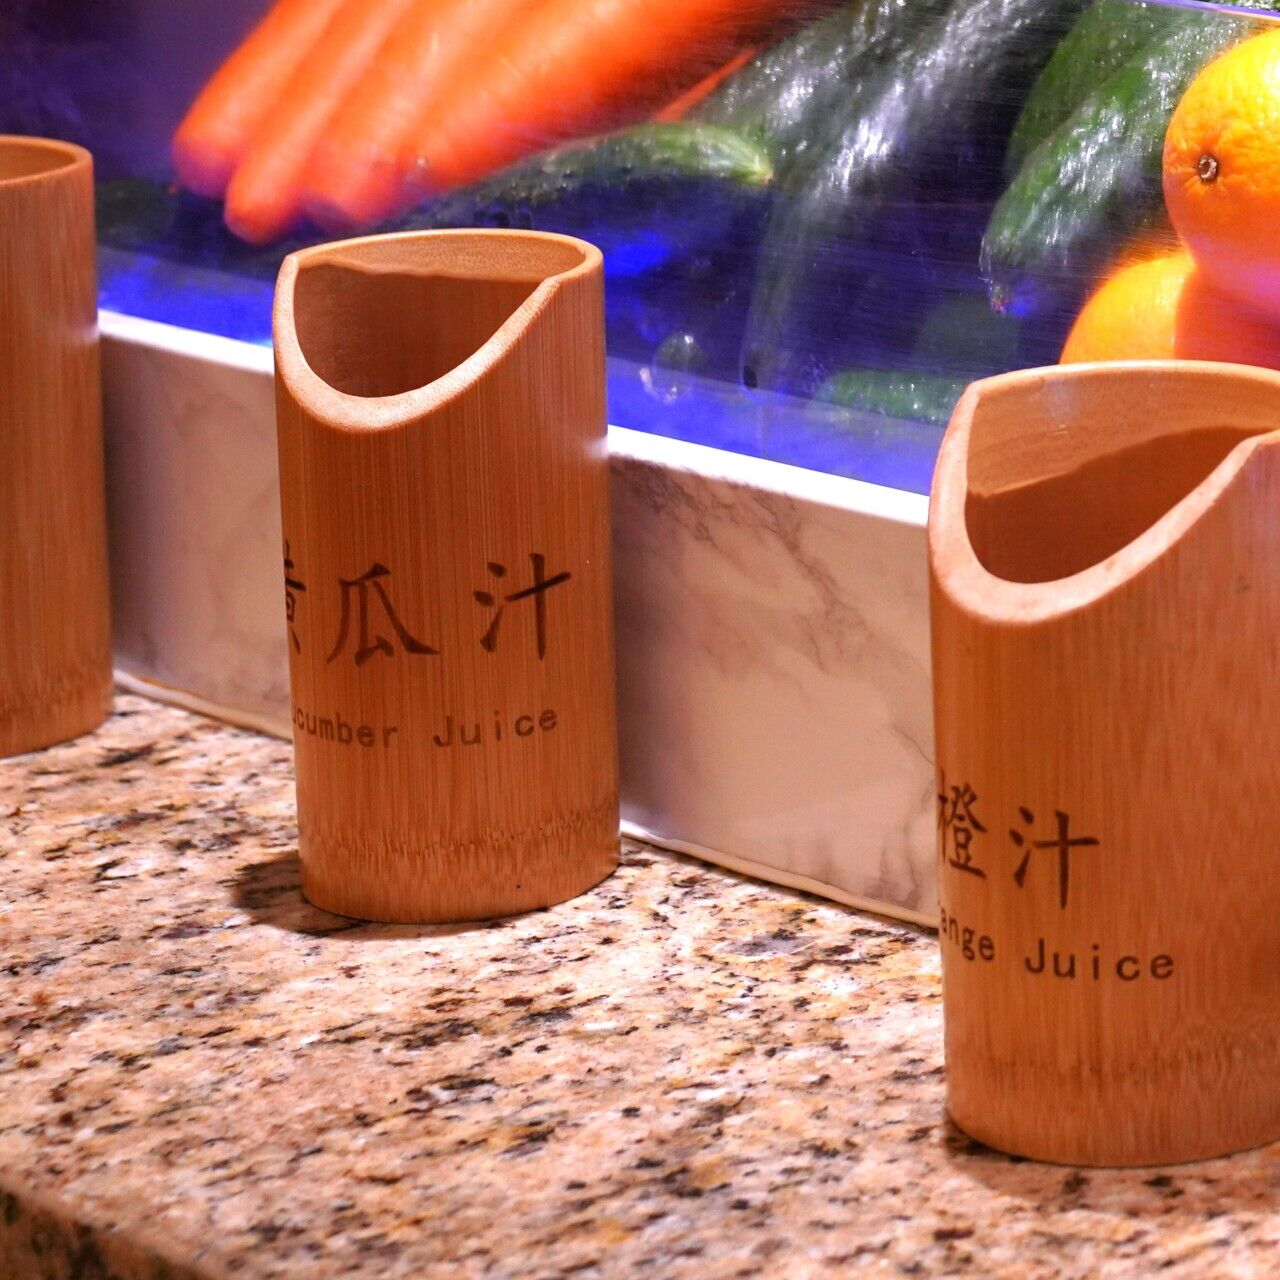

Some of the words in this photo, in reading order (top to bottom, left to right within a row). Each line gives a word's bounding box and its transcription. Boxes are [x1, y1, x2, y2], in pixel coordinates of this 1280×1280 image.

[293, 706, 399, 748] cumber
[432, 708, 557, 748] Juice
[938, 766, 1101, 911] 橙汁
[1024, 937, 1175, 982] Juice
